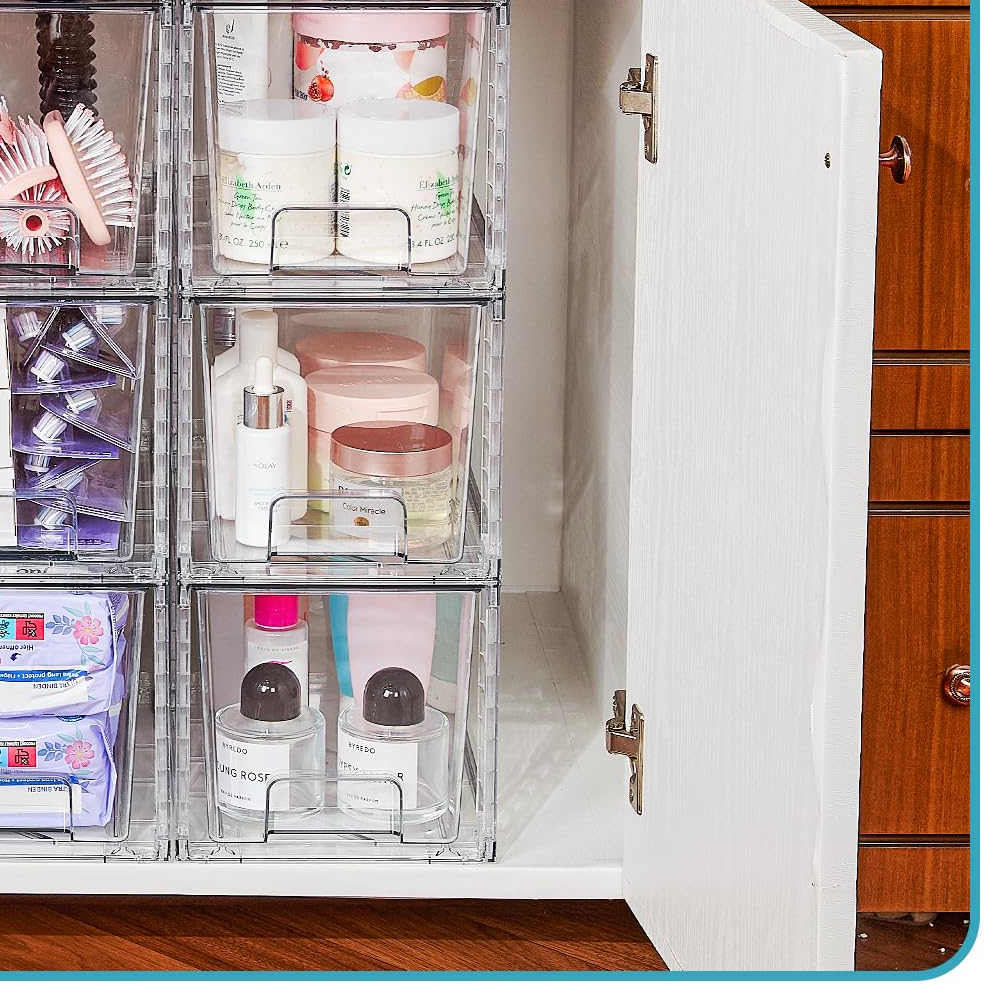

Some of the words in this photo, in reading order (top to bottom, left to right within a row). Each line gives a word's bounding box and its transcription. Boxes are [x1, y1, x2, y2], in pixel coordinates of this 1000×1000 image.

[255, 181, 281, 190] Arden
[248, 239, 265, 249] 250
[343, 502, 358, 513] Color
[359, 505, 386, 515] Miracle
[20, 643, 34, 651] Hier
[22, 671, 45, 680] protect
[222, 741, 248, 755] BYREDO
[348, 741, 376, 754] BYREDO
[217, 763, 237, 778] UNG
